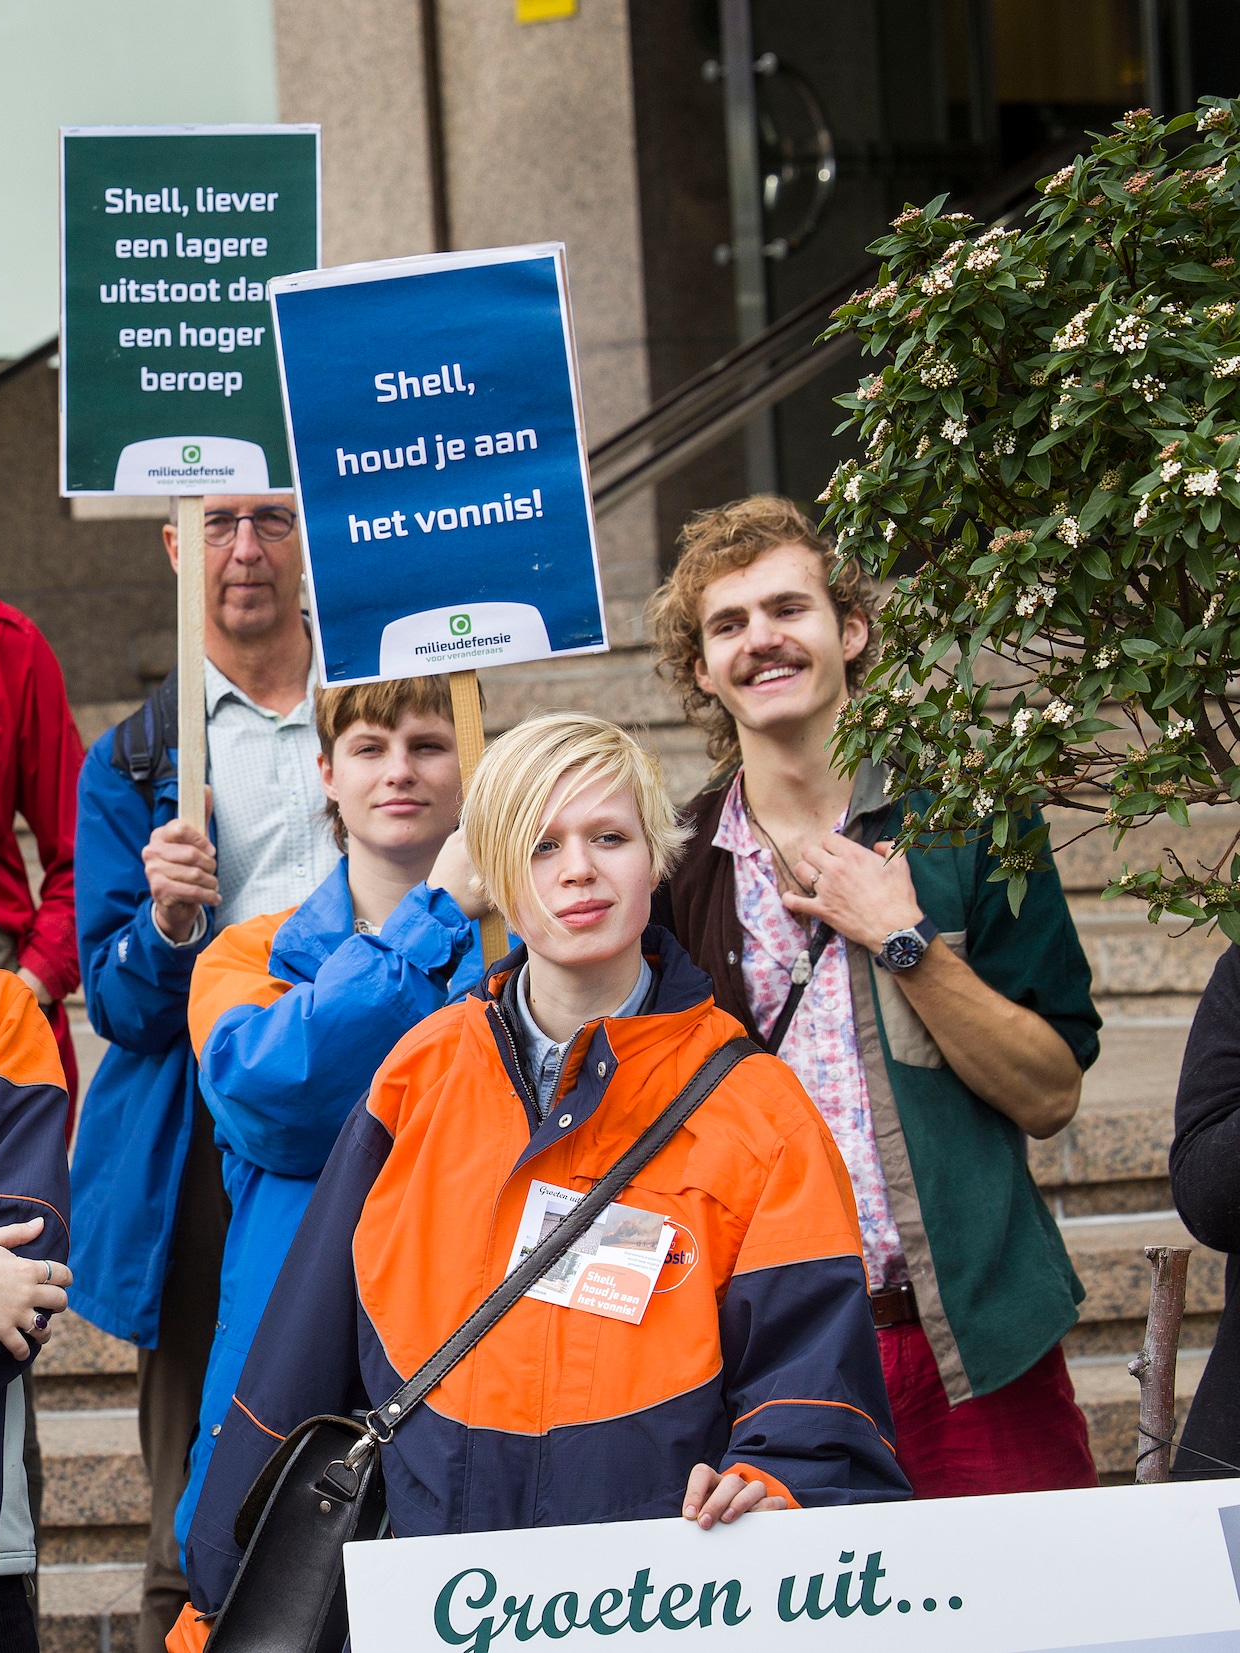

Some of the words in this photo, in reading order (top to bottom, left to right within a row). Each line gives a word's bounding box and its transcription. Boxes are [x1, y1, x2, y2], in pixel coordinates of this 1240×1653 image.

[104, 186, 189, 217] Shell,
[196, 186, 279, 213] liever
[115, 238, 168, 259] een
[175, 232, 268, 264] lagere
[100, 277, 221, 303] uitstoot
[119, 327, 172, 348] een
[179, 321, 266, 353] hoger
[140, 366, 243, 397] beroep
[374, 362, 475, 403] Shell,
[336, 440, 426, 476] houd
[434, 434, 466, 471] je
[474, 427, 538, 457] aan
[148, 465, 235, 477] milieudefensie
[348, 507, 409, 543] het
[413, 487, 544, 533] vonnis!
[414, 632, 512, 655] milieudefensie
[425, 654, 446, 663] voor
[446, 646, 504, 660] veranderaars
[539, 1185, 568, 1200] Groeten
[663, 1246, 695, 1265] ostnl
[586, 1270, 617, 1288] Shell,
[577, 1293, 597, 1307] het
[597, 1300, 637, 1317] vonnis!
[581, 1282, 608, 1297] houd
[608, 1288, 619, 1300] je
[620, 1293, 640, 1305] aan
[433, 1566, 752, 1653] Groeten
